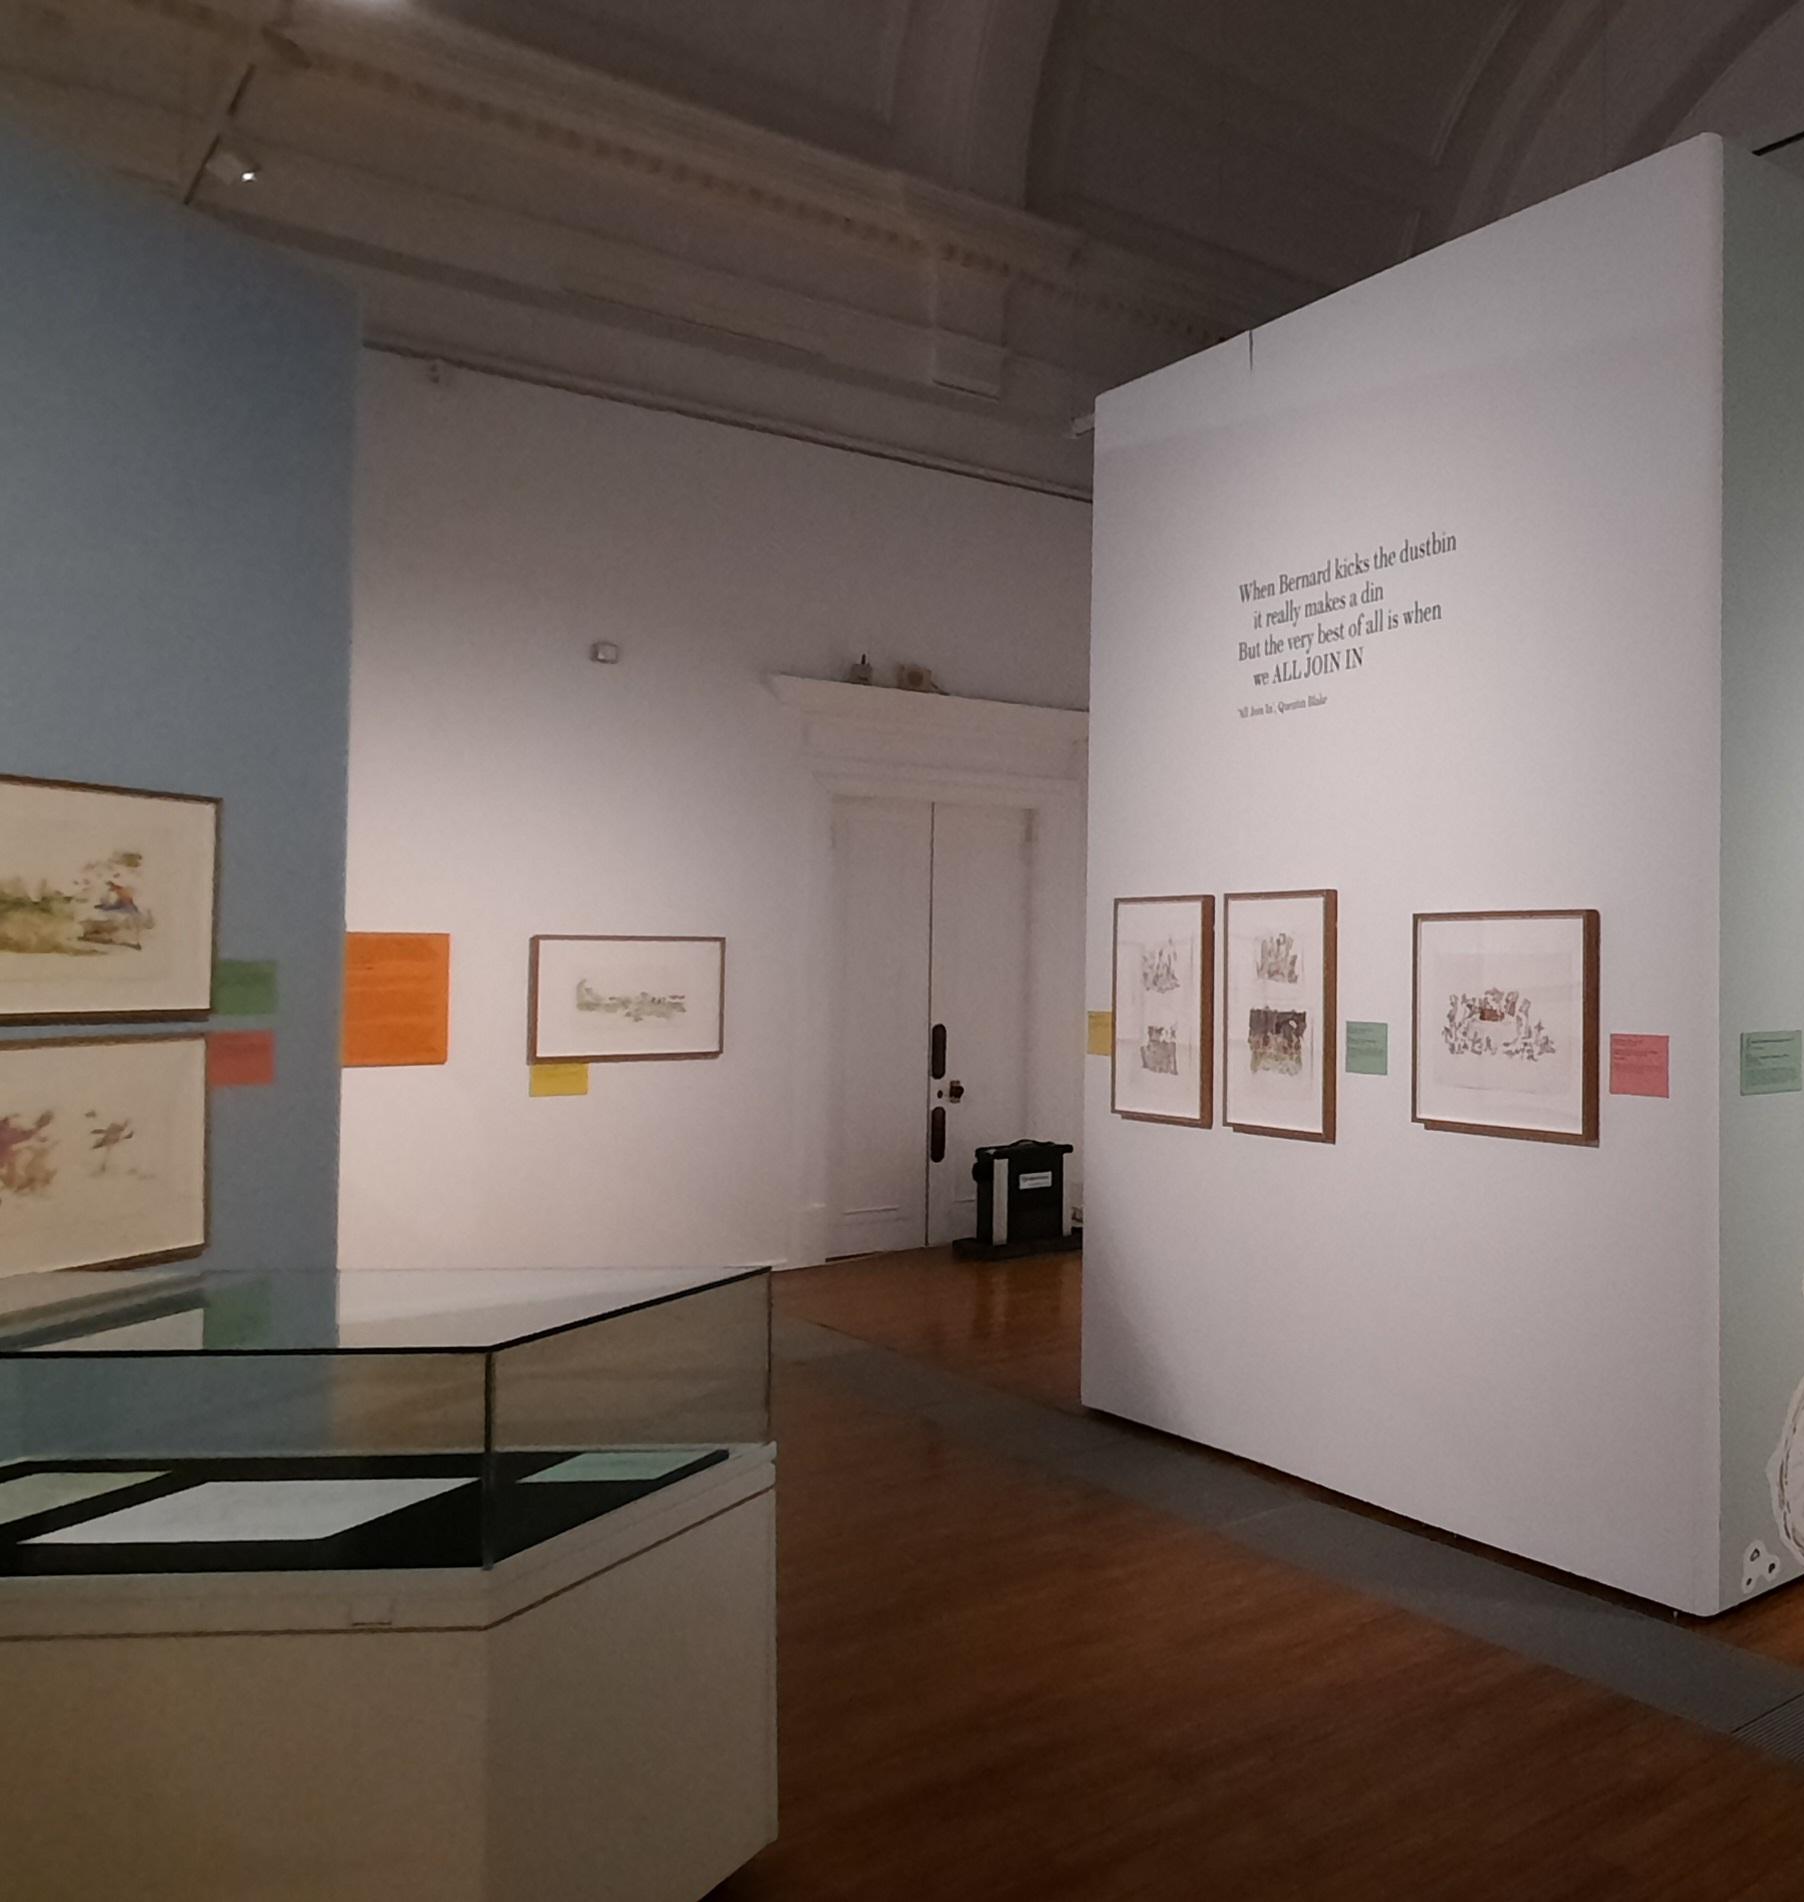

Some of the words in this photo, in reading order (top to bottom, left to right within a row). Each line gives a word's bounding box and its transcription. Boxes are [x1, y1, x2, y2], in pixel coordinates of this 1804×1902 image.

[1239, 579, 1275, 603] When
[1279, 559, 1331, 595] Bernard
[1334, 552, 1370, 580] kicks
[1373, 545, 1396, 570] the
[1399, 530, 1457, 564] dustbin
[1238, 641, 1260, 662] But
[1264, 633, 1284, 656] the
[1287, 632, 1314, 655] very
[1317, 622, 1345, 645] best
[1348, 612, 1365, 638] of
[1365, 608, 1383, 635] all
[1387, 609, 1399, 630] is
[1403, 600, 1442, 625] when
[1253, 610, 1262, 630] it
[1265, 599, 1301, 628] really
[1304, 590, 1346, 618] makes
[1349, 592, 1357, 608] a
[1360, 580, 1383, 604] din
[1253, 671, 1270, 686] we
[1272, 660, 1302, 684] ALL
[1303, 651, 1341, 679] JOIN
[1345, 646, 1364, 670] IN
